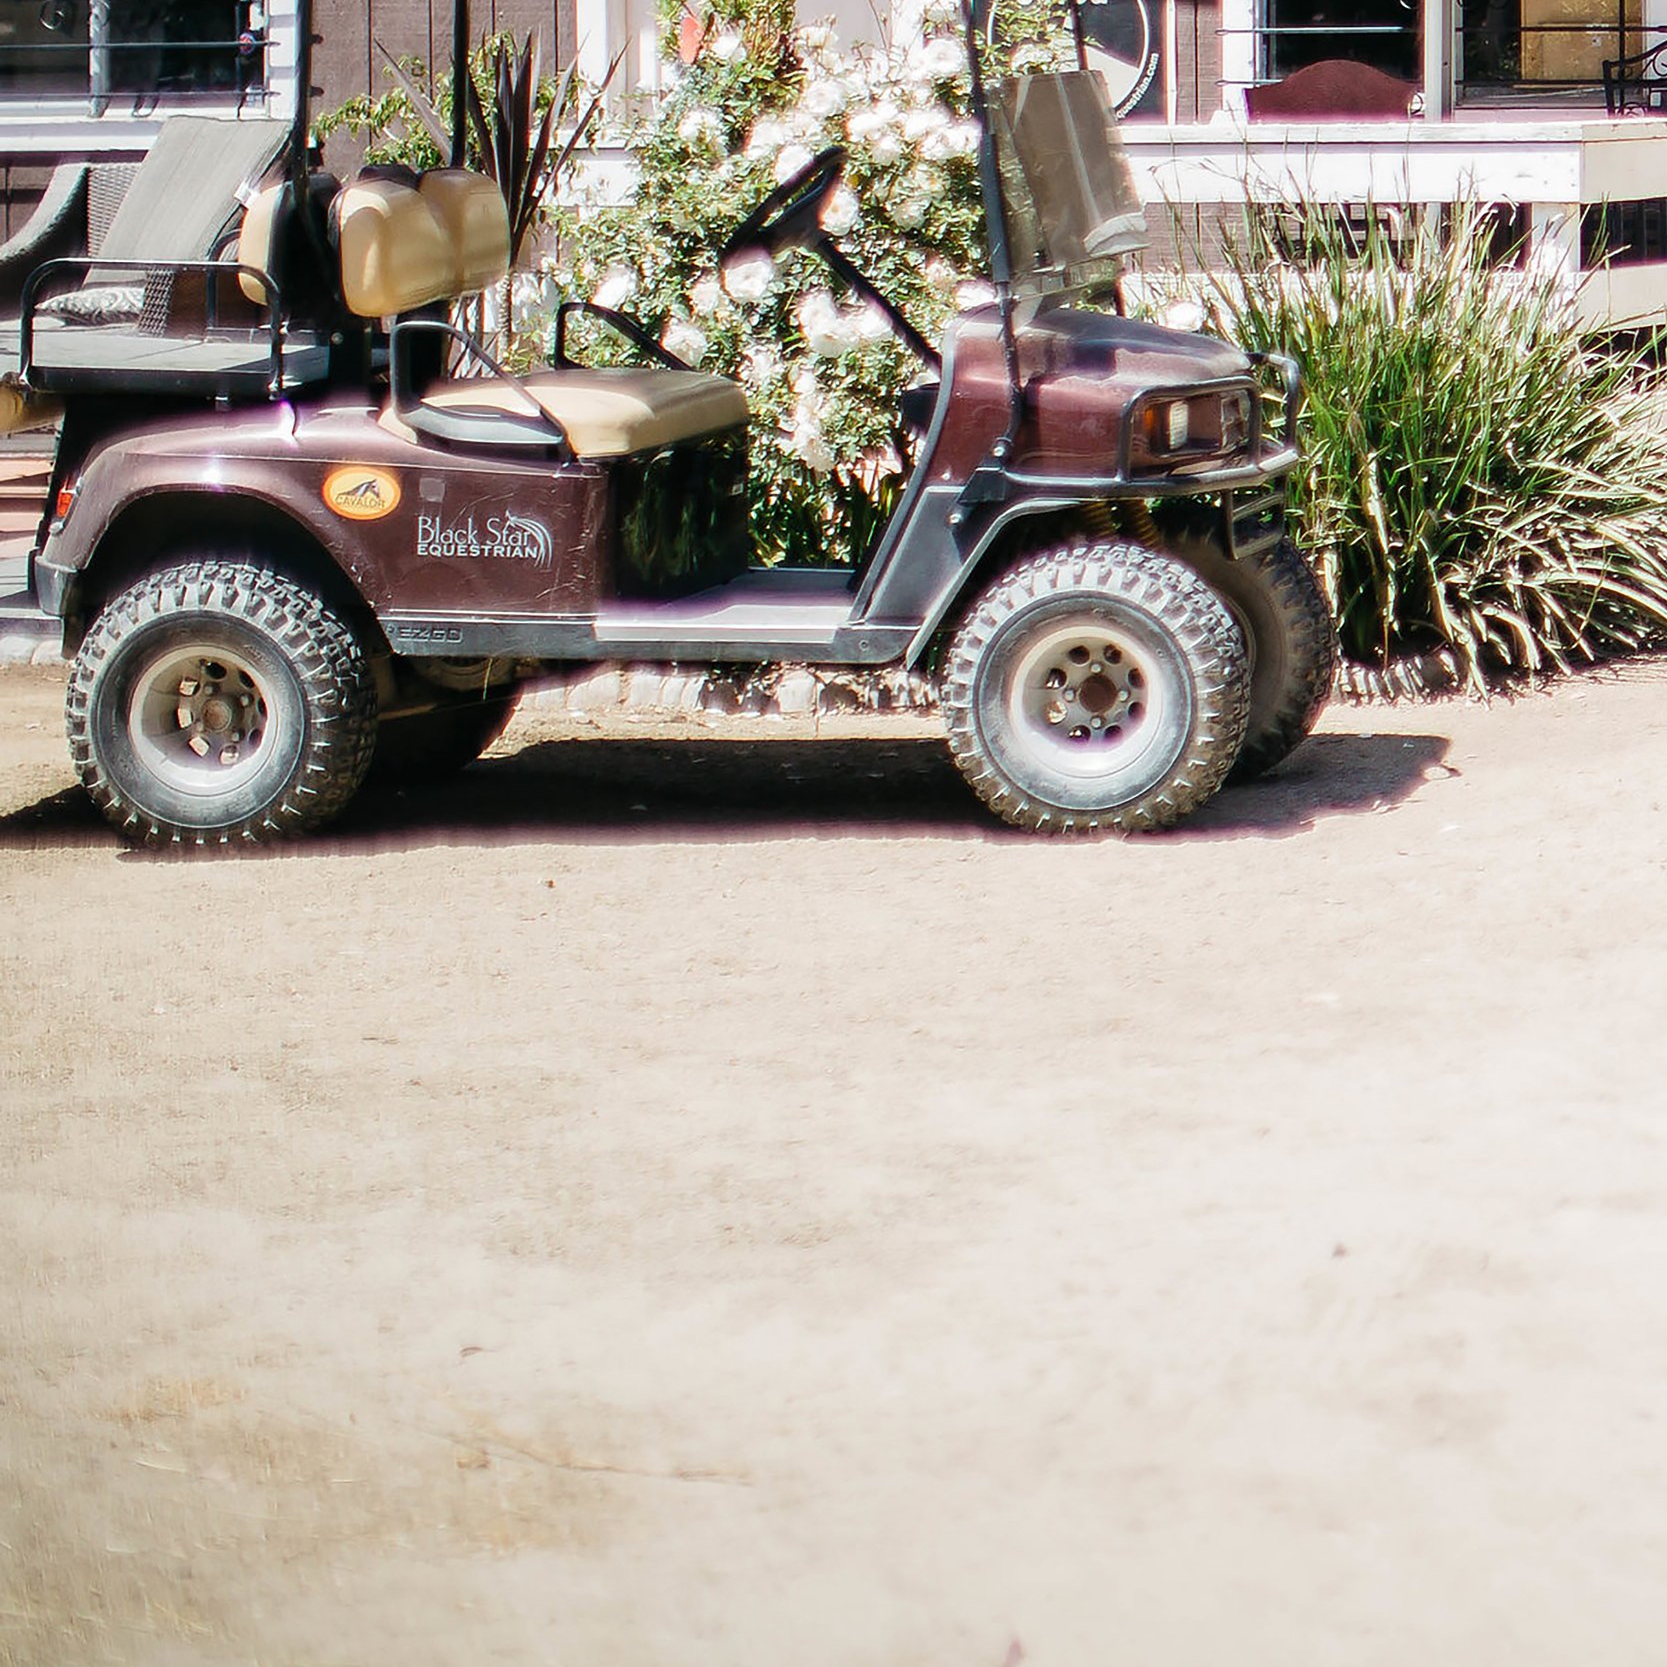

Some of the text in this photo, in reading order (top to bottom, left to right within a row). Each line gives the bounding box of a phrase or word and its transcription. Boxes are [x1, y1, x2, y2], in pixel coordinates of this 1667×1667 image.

[418, 516, 531, 546] Black Star
[416, 543, 539, 559] EQUESTRIAN
